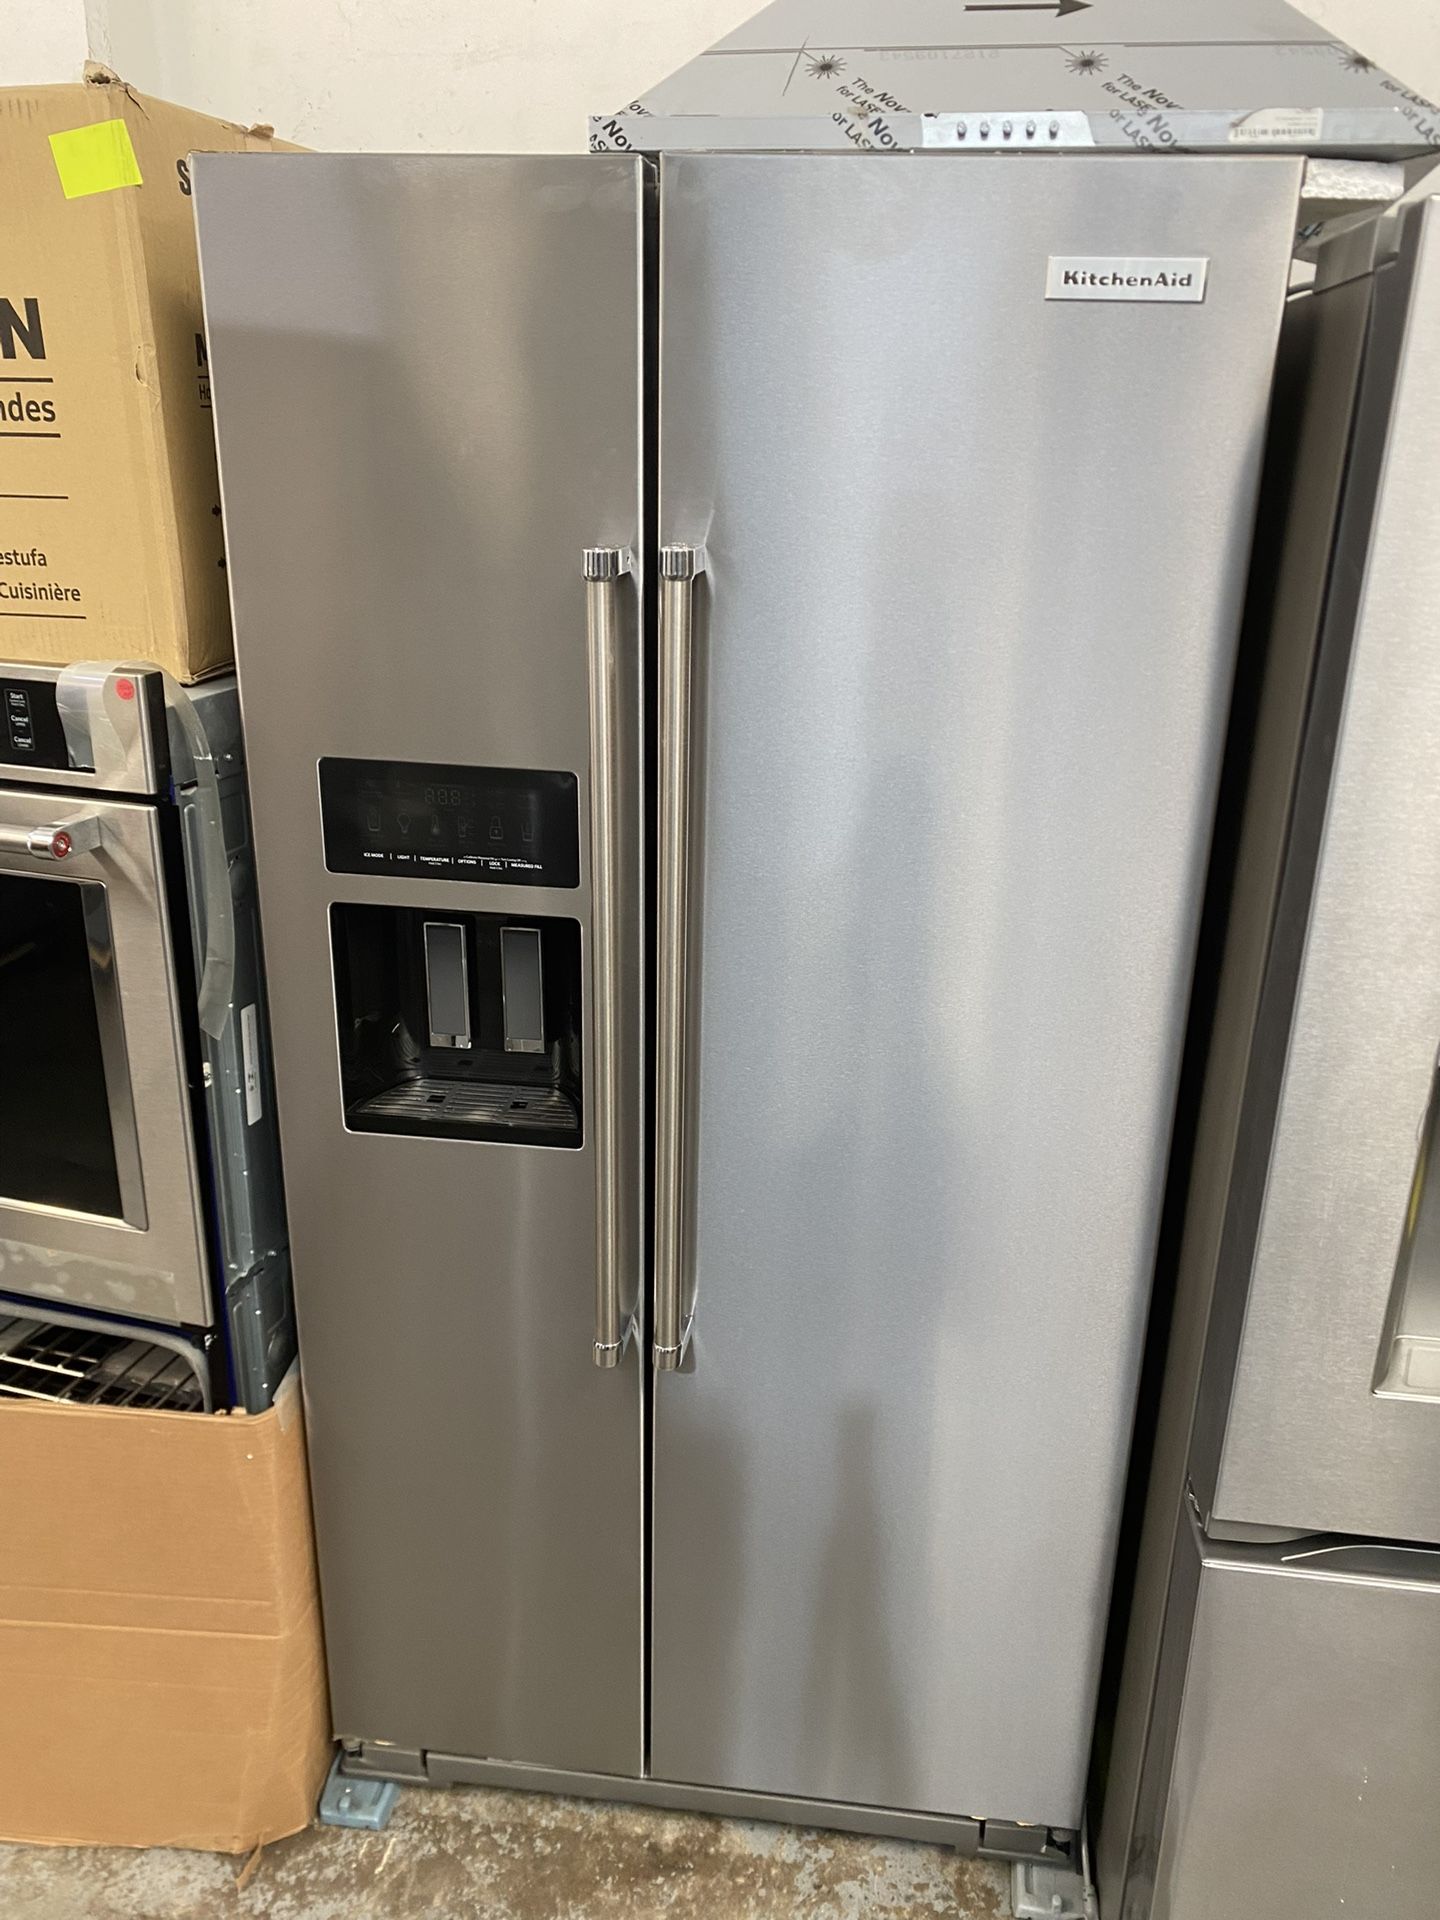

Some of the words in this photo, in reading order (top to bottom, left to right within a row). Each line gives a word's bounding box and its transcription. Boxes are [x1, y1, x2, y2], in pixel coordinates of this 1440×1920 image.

[852, 77, 874, 95] The
[1117, 73, 1142, 91] The
[836, 85, 855, 98] for
[852, 95, 886, 114] LASE
[1101, 82, 1121, 94] for
[1120, 92, 1158, 111] LASE
[176, 159, 191, 195] S
[1063, 270, 1192, 287] KitchenAid
[0, 582, 81, 601] Cuisinière
